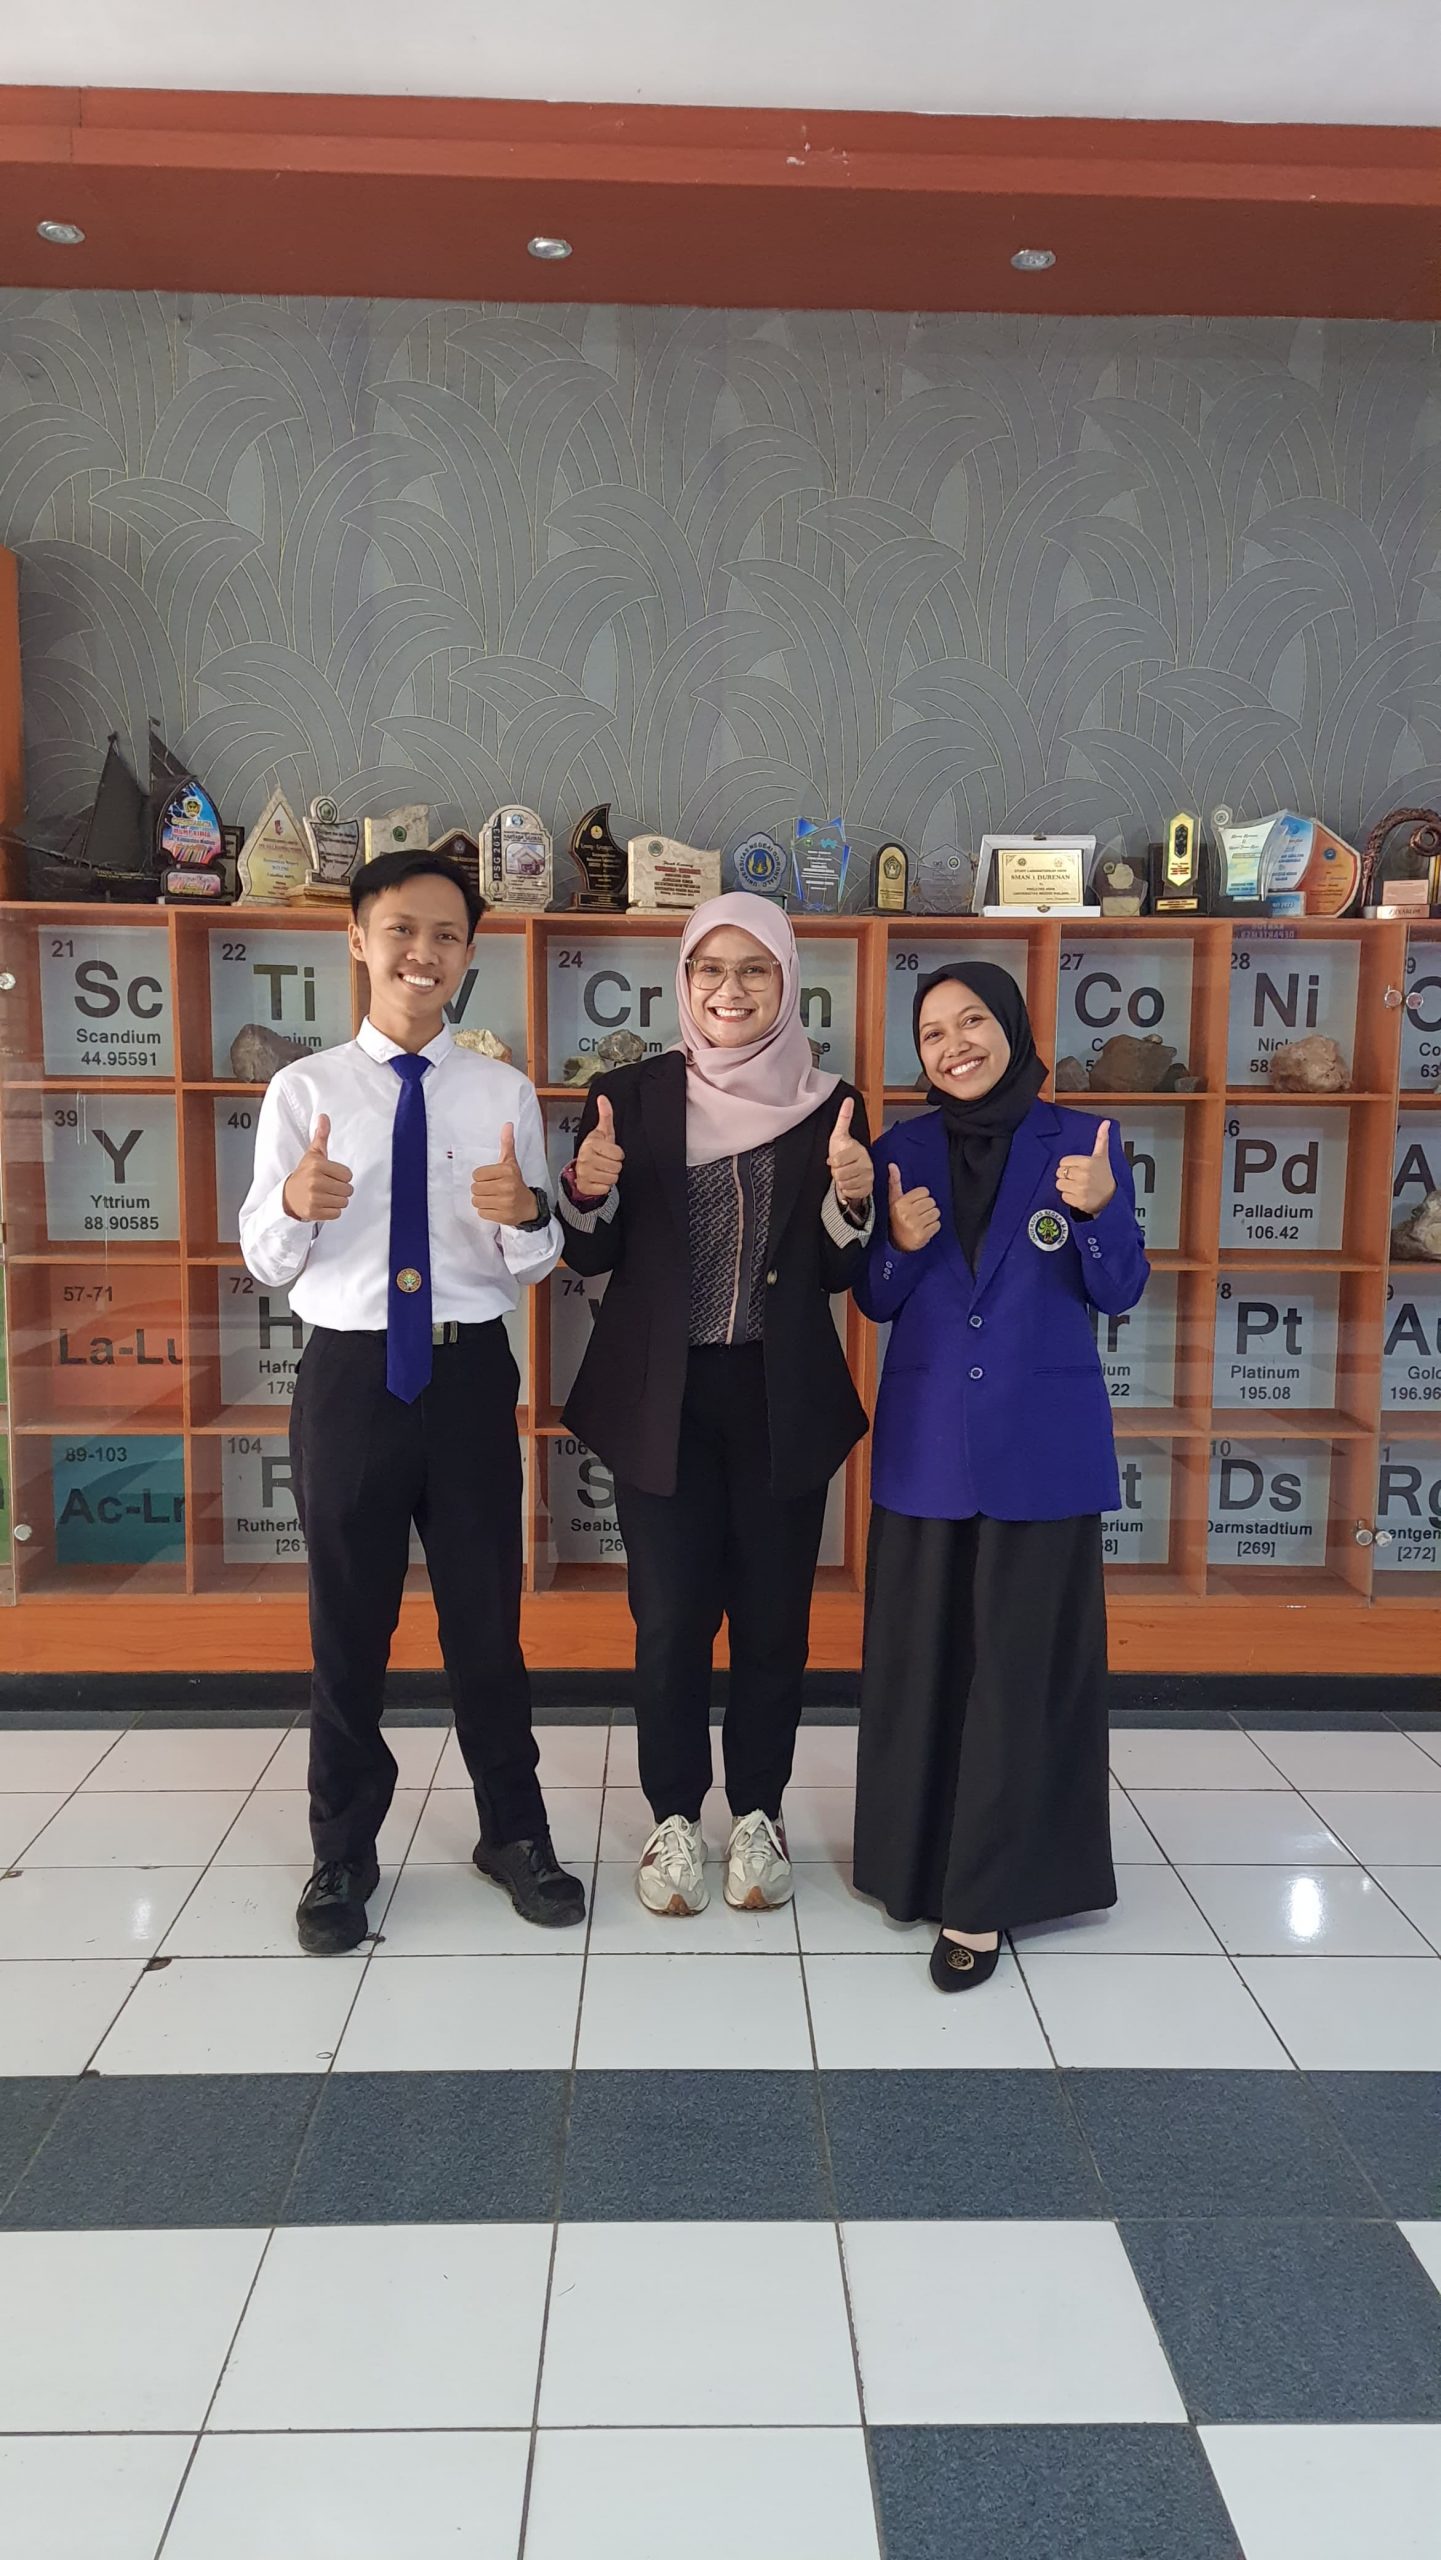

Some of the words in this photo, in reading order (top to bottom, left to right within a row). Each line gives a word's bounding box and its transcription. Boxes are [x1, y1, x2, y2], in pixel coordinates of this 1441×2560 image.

[52, 940, 74, 958] 21
[222, 944, 246, 960] 22
[558, 950, 583, 968] 24
[896, 954, 919, 970] 26
[1060, 953, 1084, 970] 27
[1405, 957, 1416, 974] 9
[74, 960, 163, 1019] Sc
[253, 964, 316, 1022] Ti
[584, 970, 662, 1028] Cr
[800, 987, 832, 1028] n
[1074, 972, 1164, 1028] Co
[1254, 972, 1320, 1028] Ni
[1406, 976, 1441, 1032] C
[76, 1028, 161, 1044] Scandium
[81, 1052, 158, 1067] 44.95591
[1250, 1060, 1273, 1072] 58.
[54, 1110, 78, 1127] 39
[228, 1112, 252, 1129] 40
[559, 1116, 581, 1132] 42
[1224, 1120, 1240, 1136] 6
[92, 1130, 144, 1184] Y
[1124, 1142, 1156, 1194] h
[1232, 1139, 1319, 1194] Pd
[1393, 1144, 1436, 1198] A
[90, 1195, 150, 1209] Yttrium
[1232, 1204, 1314, 1219] Palladium
[84, 1217, 159, 1230] 88.90585
[1246, 1226, 1299, 1240] 106.42
[64, 1286, 113, 1302] 57-71
[230, 1278, 254, 1294] 72
[562, 1280, 585, 1296] 74
[258, 1296, 304, 1350] H
[1236, 1302, 1302, 1356] Pt
[1384, 1303, 1441, 1356] A
[1230, 1365, 1300, 1380] Platinum
[267, 1381, 296, 1394] 178
[1240, 1386, 1291, 1400] 195.08
[66, 1447, 128, 1462] 89-103
[228, 1438, 262, 1454] 104
[554, 1439, 590, 1455] 106
[1210, 1440, 1232, 1457] 10
[576, 1457, 616, 1509] S
[1122, 1464, 1142, 1510] t
[1218, 1458, 1302, 1512] Ds
[237, 1519, 304, 1532] Rutherf
[1206, 1520, 1313, 1536] Darmstadtium
[600, 1538, 622, 1554] [26
[1236, 1540, 1276, 1557] [269]
[1398, 1546, 1436, 1562] [272]
